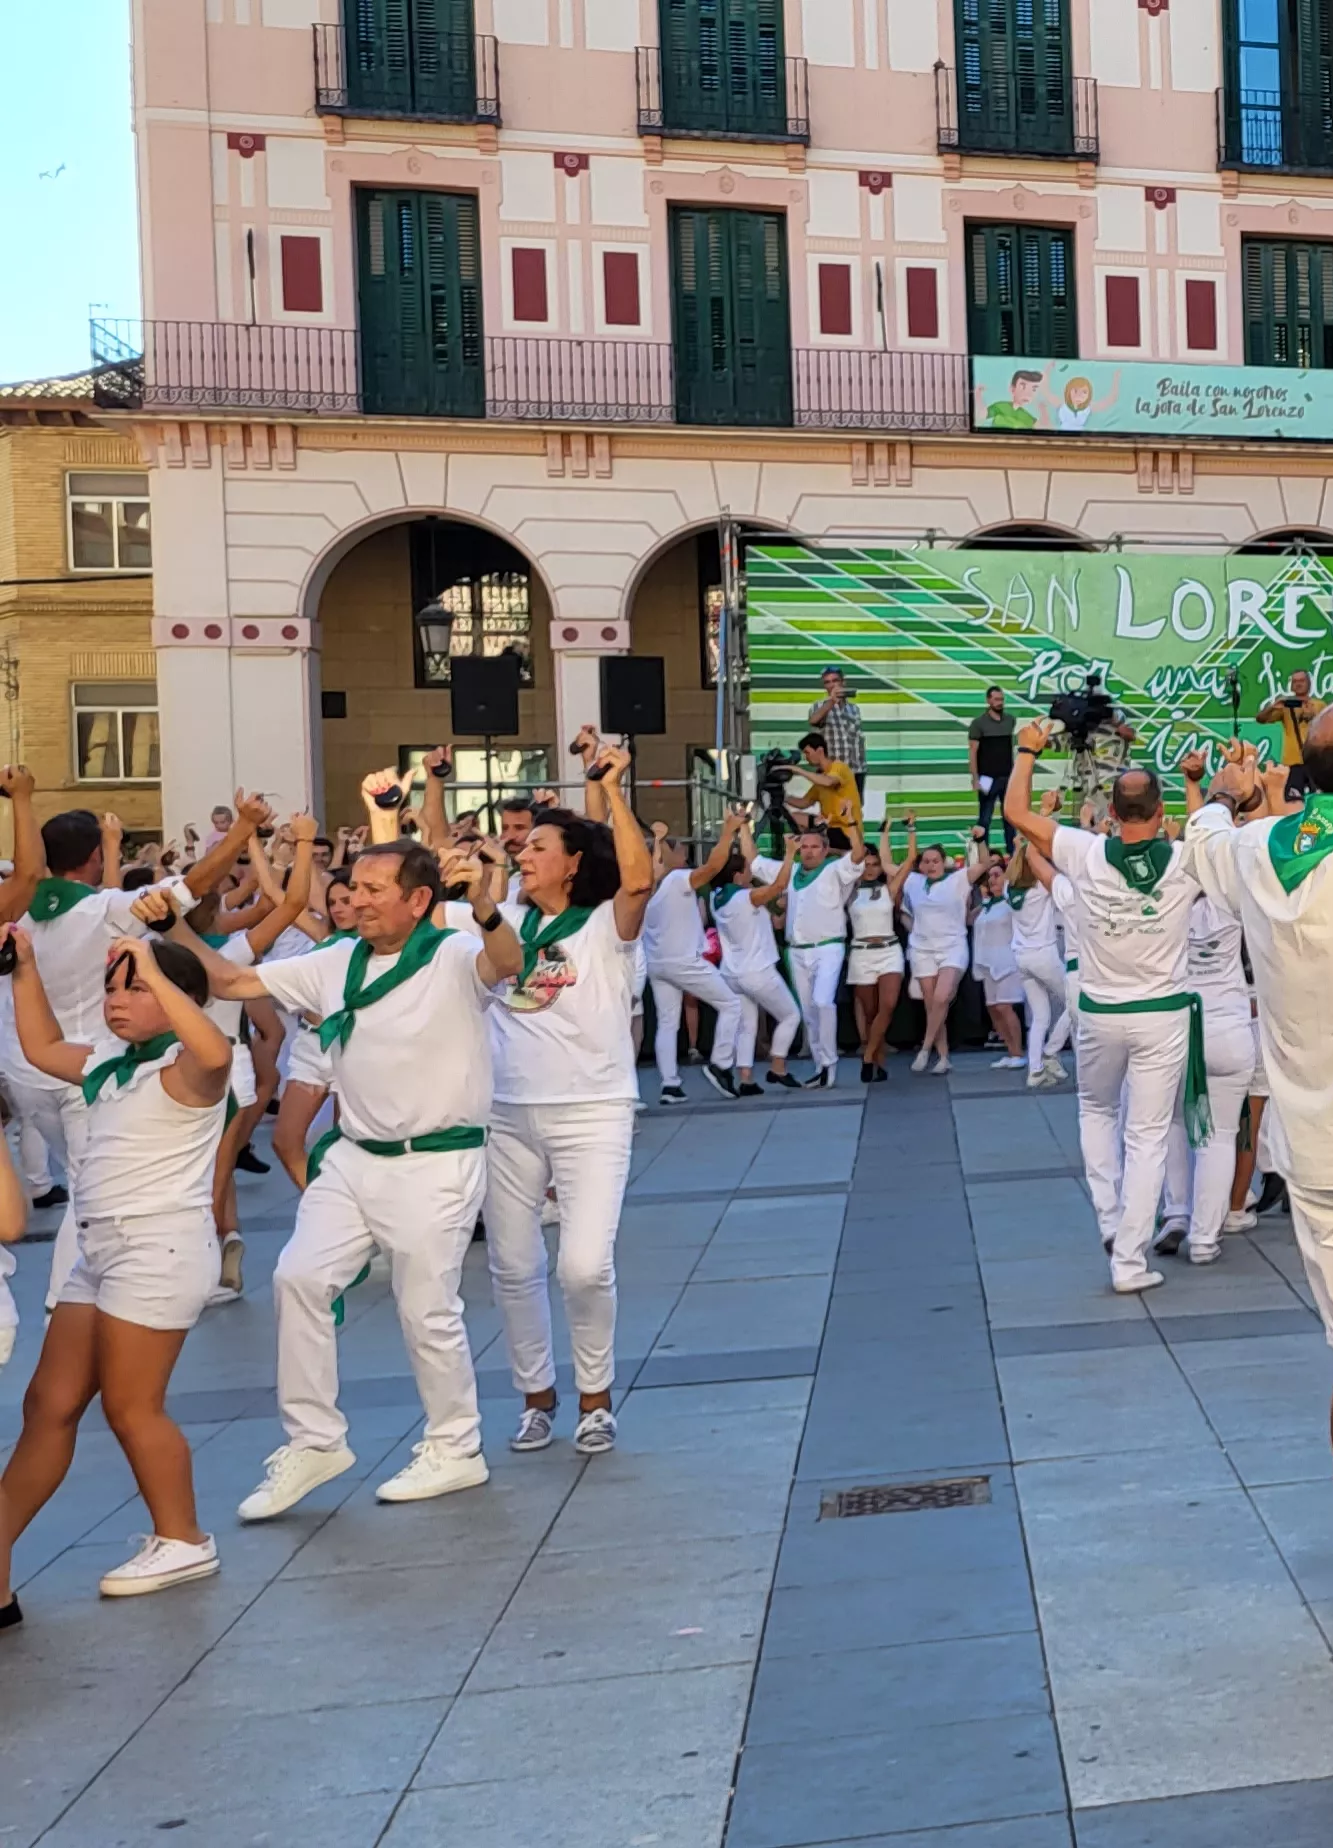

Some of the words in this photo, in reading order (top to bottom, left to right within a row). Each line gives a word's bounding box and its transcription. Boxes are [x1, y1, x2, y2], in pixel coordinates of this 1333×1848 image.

[1156, 377, 1201, 398] Baila
[1205, 384, 1230, 398] con
[1233, 384, 1289, 402] nosotros
[1135, 397, 1150, 414] la
[1150, 400, 1182, 419] jota
[1186, 398, 1206, 416] de
[1210, 398, 1239, 417] San
[1242, 402, 1305, 419] Lorenzo
[962, 565, 1081, 634] SAN
